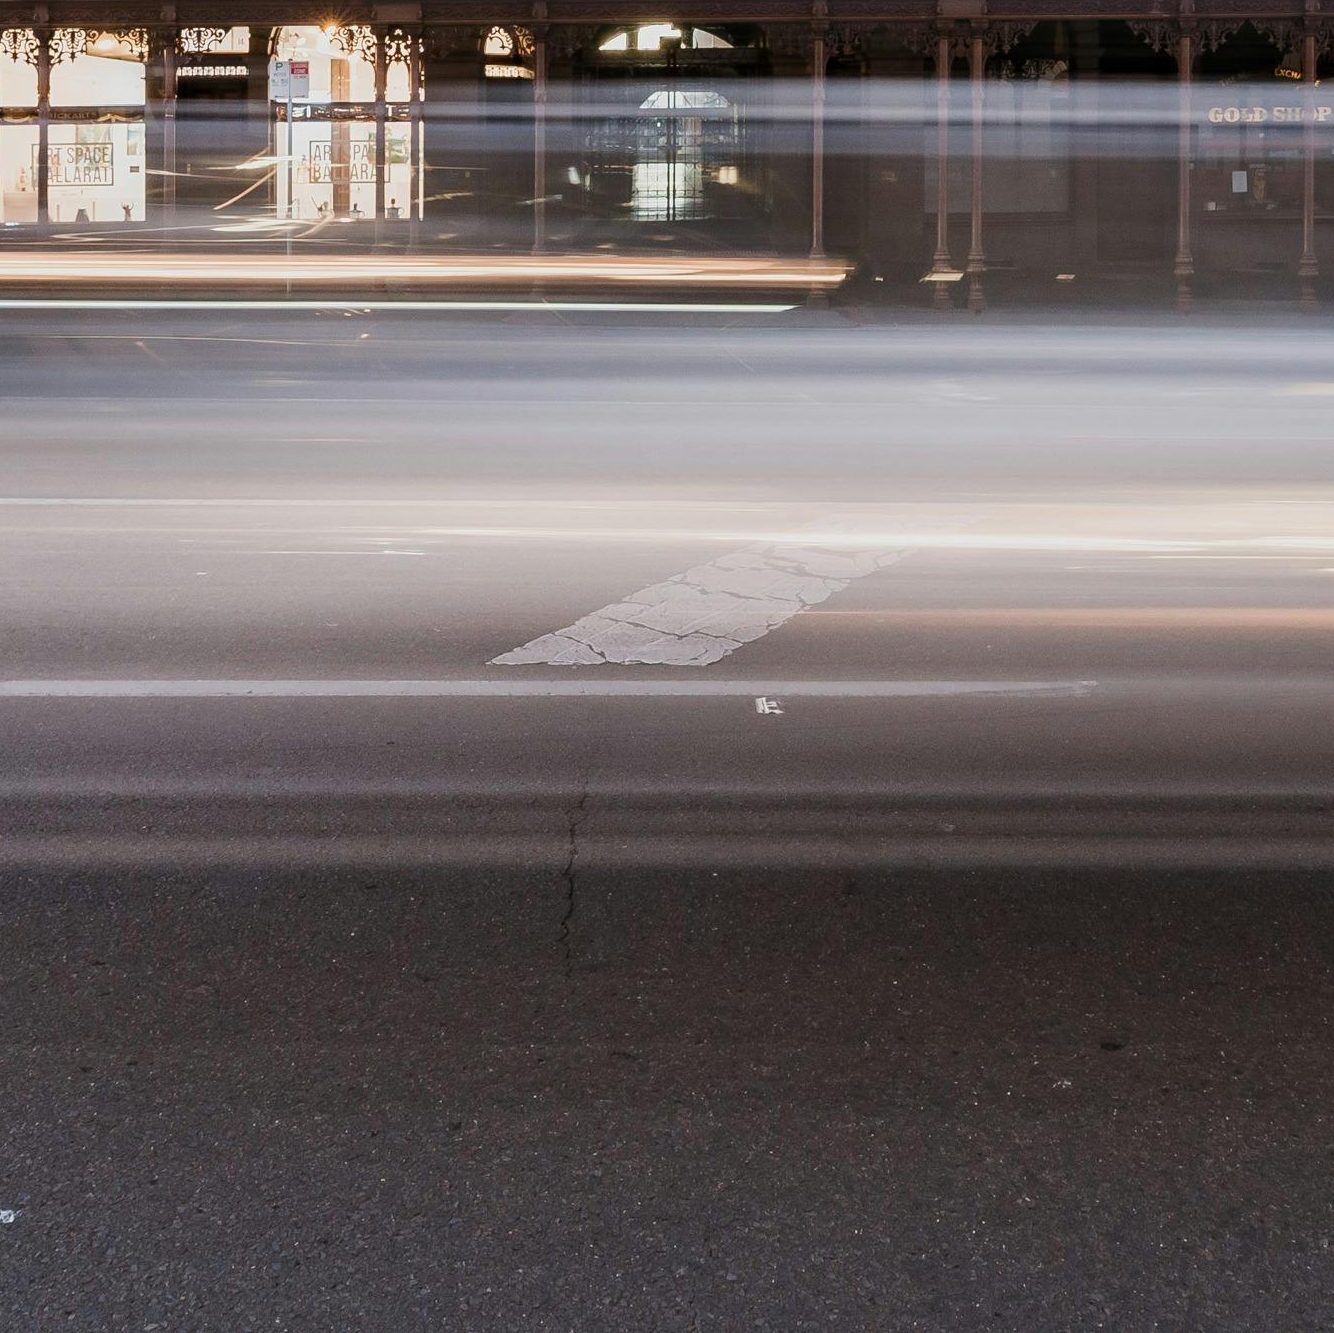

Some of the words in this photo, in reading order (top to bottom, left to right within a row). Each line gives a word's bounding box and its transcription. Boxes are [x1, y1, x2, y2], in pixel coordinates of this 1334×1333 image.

[1208, 107, 1267, 123] GOLD
[67, 147, 110, 164] SPACE
[47, 166, 108, 182] ALLARAT
